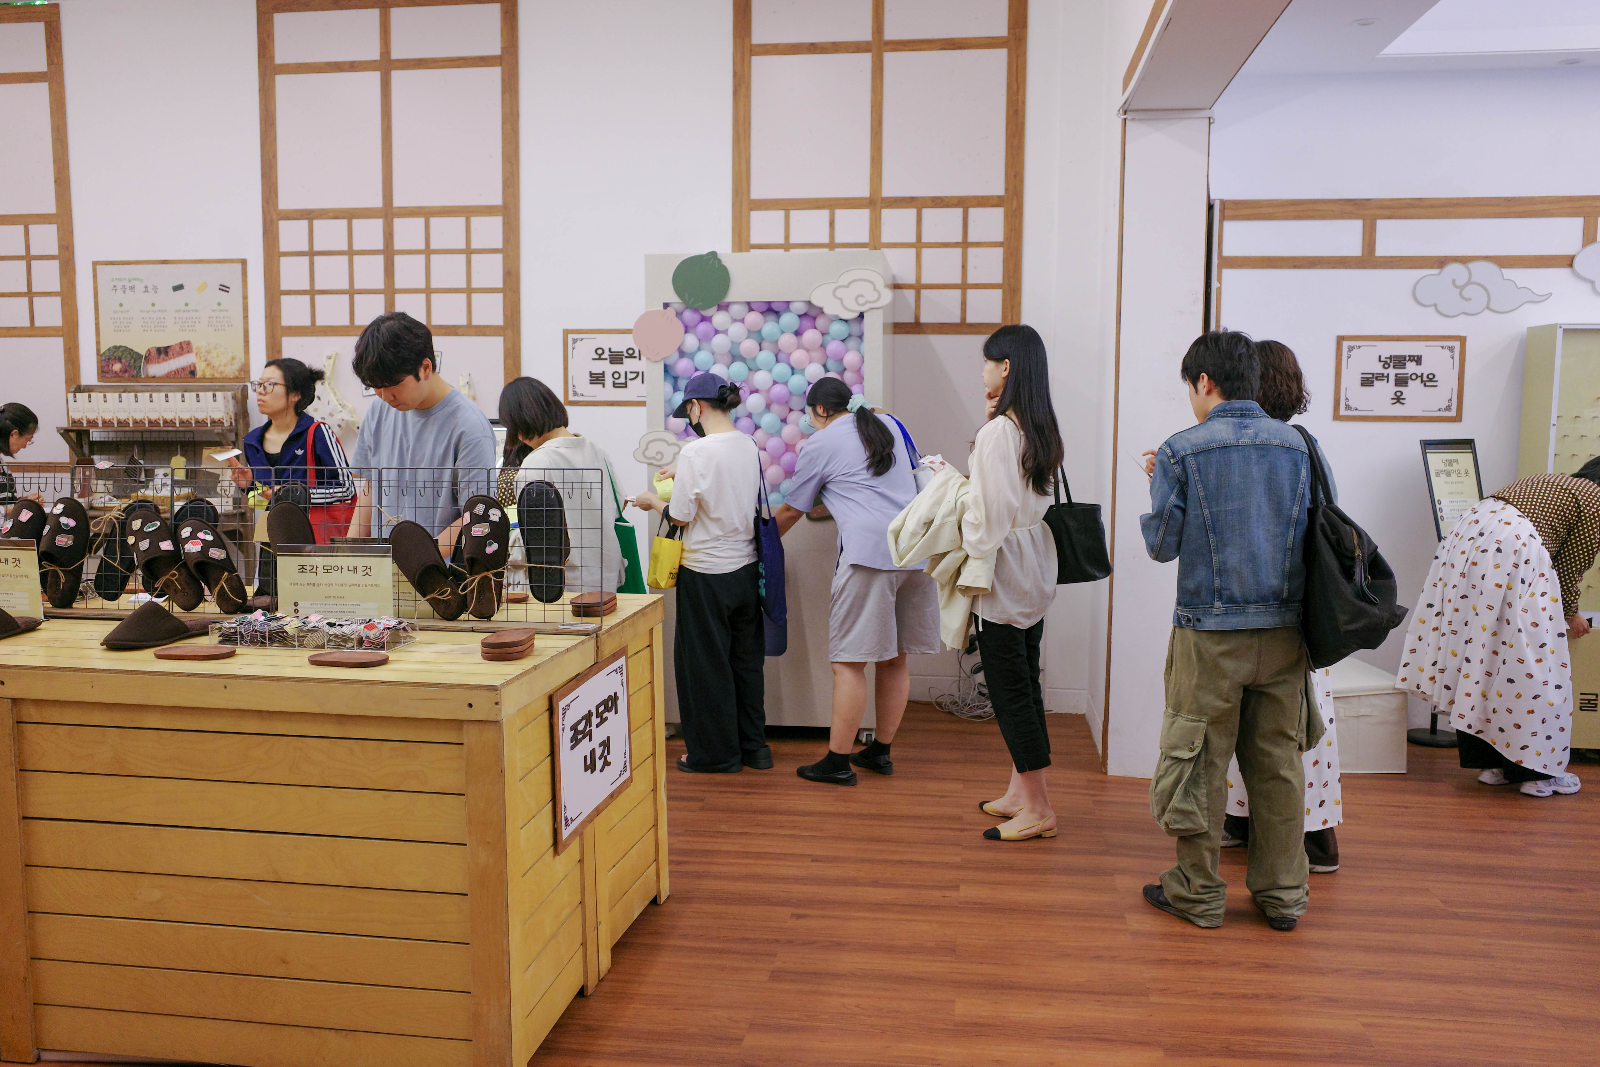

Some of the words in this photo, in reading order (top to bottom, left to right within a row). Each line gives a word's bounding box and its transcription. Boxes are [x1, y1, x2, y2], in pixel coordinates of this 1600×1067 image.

[142, 284, 159, 294] 효능
[591, 347, 642, 365] 오늘의
[1378, 354, 1422, 370] 넝쿨째
[589, 370, 606, 389] 복
[611, 370, 645, 389] 입기
[1360, 372, 1390, 387] 굴러
[1394, 372, 1439, 388] 들어온
[1390, 390, 1406, 405] 옷
[11, 557, 22, 569] 것
[297, 564, 320, 577] 조각
[322, 564, 344, 575] 모아
[346, 565, 359, 575] 내
[361, 565, 373, 577] 것
[1579, 692, 1599, 711] 굴
[569, 709, 594, 752] 조각
[595, 691, 620, 729] 모아
[583, 747, 597, 775] 내
[598, 735, 612, 773] 것
